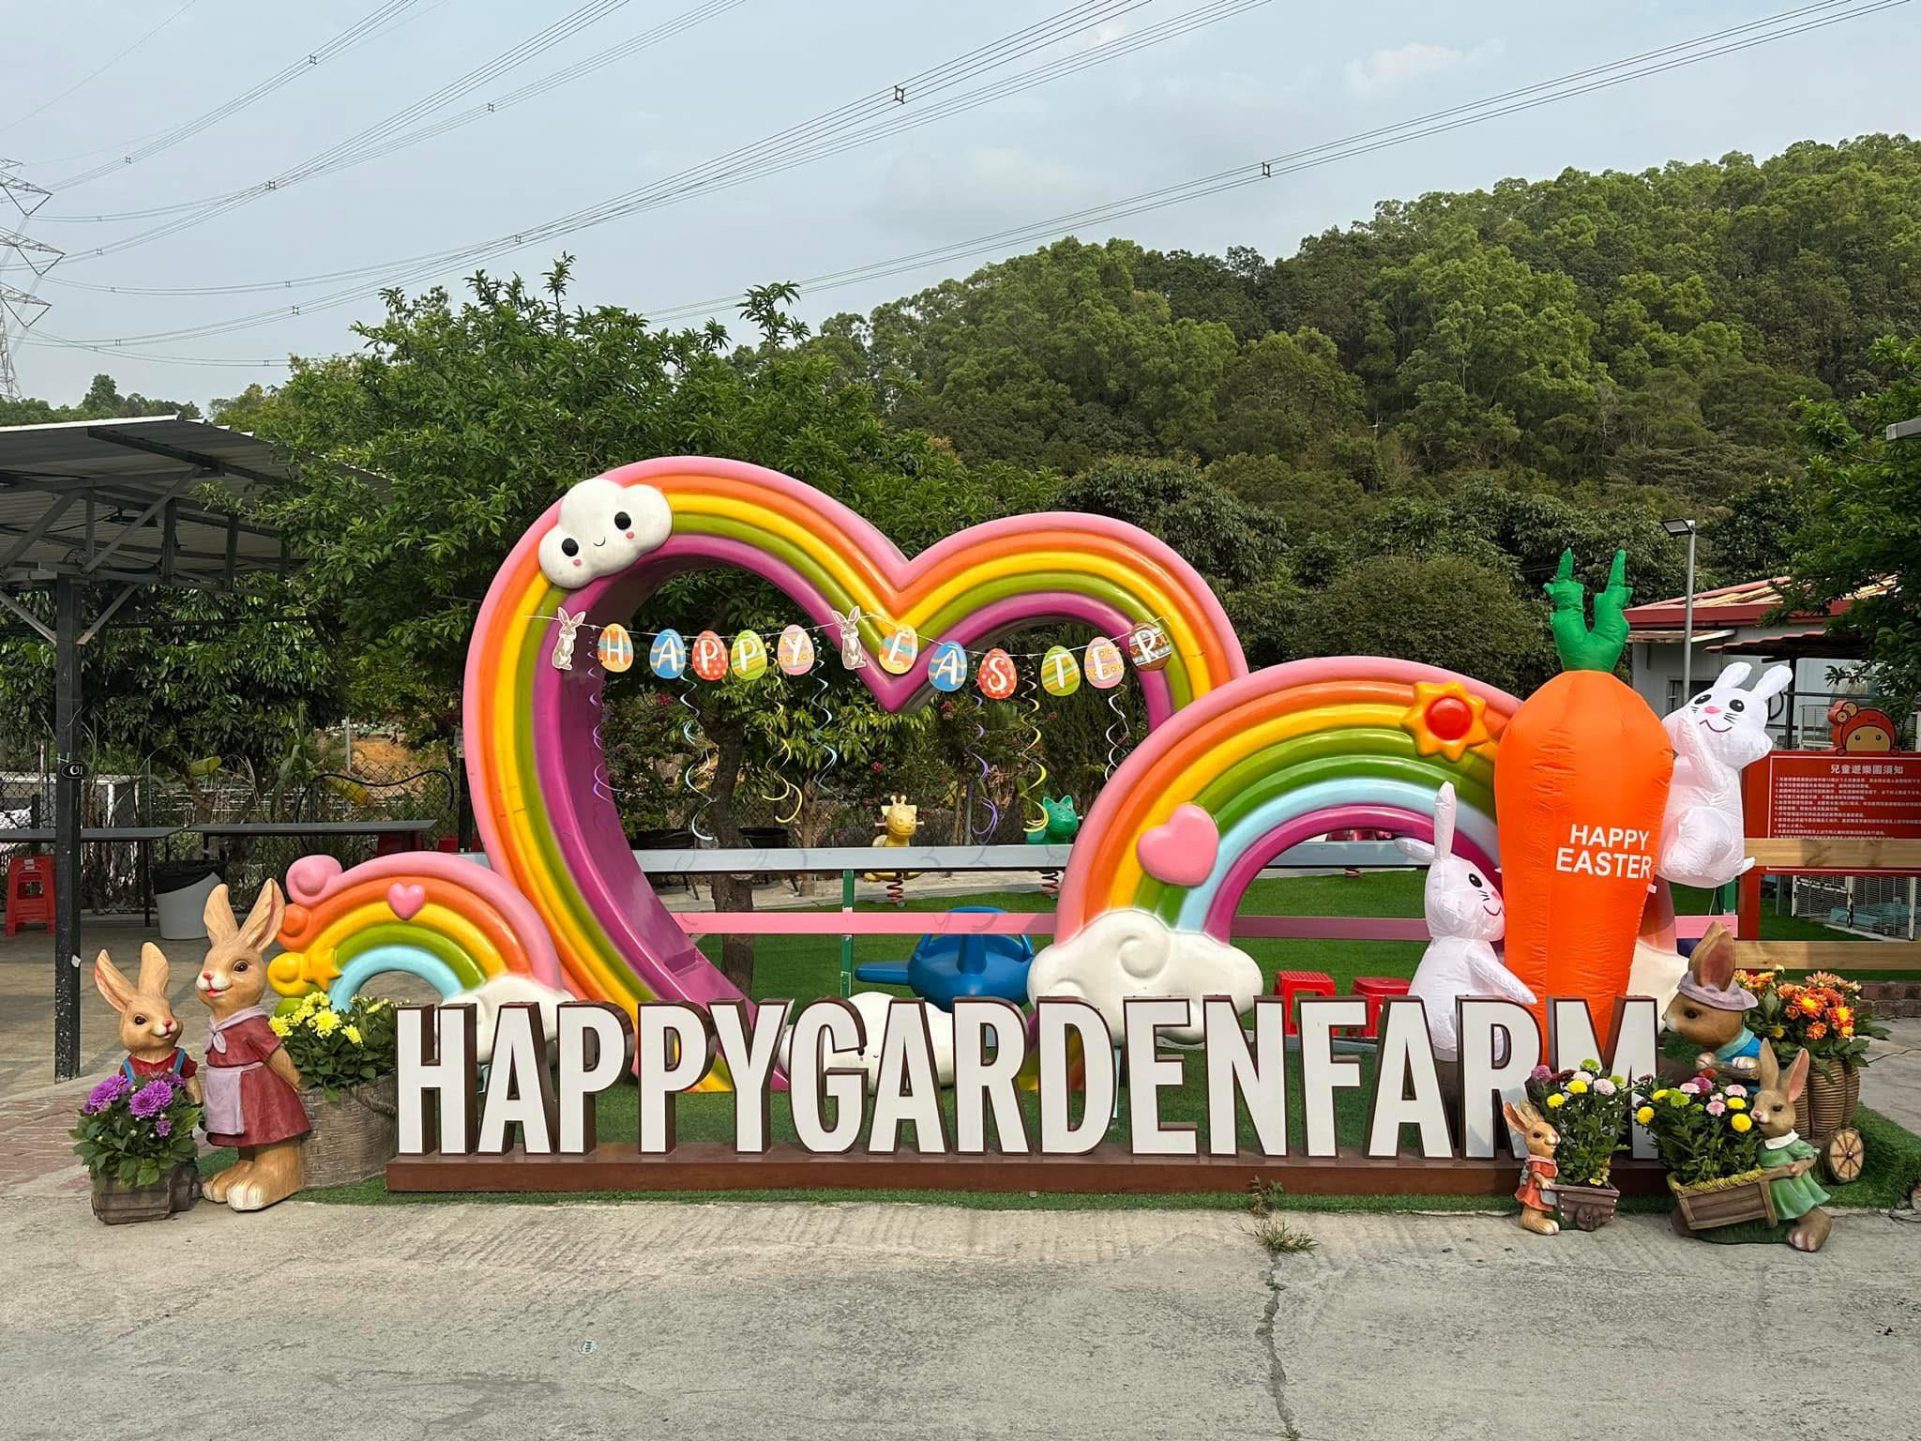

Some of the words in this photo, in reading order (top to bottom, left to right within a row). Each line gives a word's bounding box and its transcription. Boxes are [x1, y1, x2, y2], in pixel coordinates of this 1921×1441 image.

[605, 630, 805, 672] HAPPY
[887, 627, 1160, 690] EASTER
[1830, 763, 1904, 775] 兒童遊樂園須知
[1569, 823, 1650, 851] HAPPY
[1556, 847, 1652, 879] EASTER
